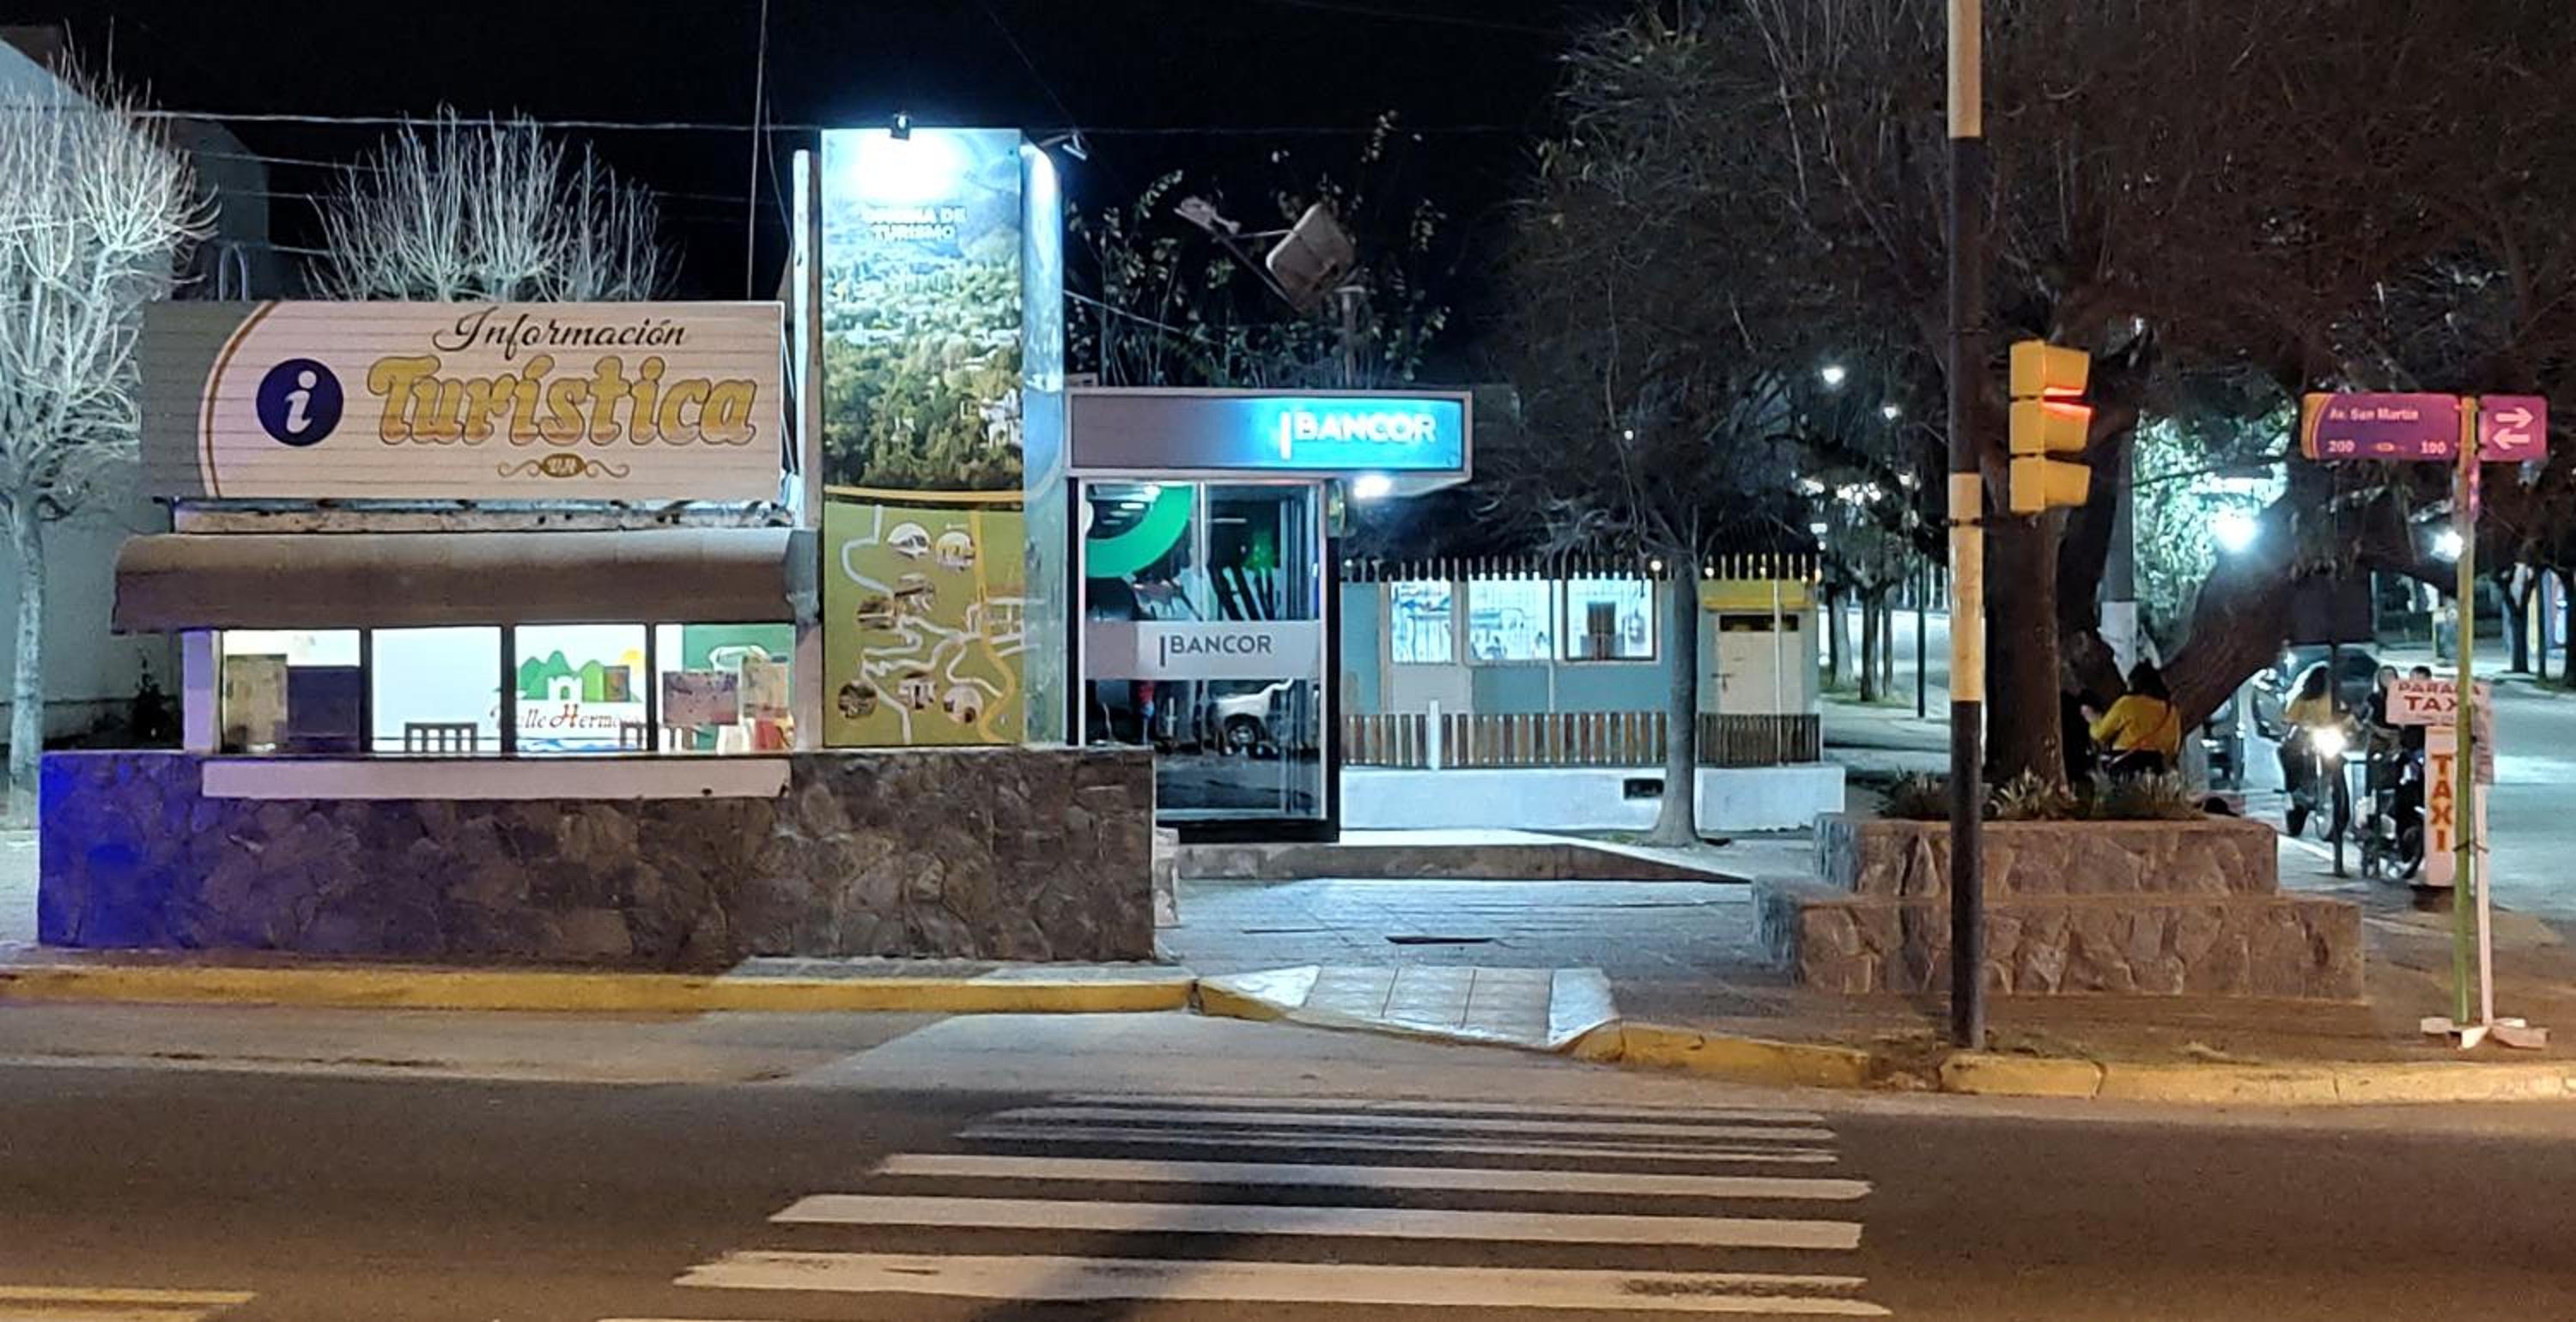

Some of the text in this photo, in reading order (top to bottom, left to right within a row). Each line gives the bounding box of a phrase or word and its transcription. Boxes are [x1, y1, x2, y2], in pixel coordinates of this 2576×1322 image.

[432, 306, 686, 361] Información
[366, 355, 757, 446] Turística
[2350, 407, 2376, 421] San
[1294, 410, 1437, 443] BANCOR
[2328, 440, 2356, 453] 200
[2420, 440, 2447, 455] 100
[1170, 634, 1273, 654] BANCOR
[2398, 682, 2481, 696] PARA
[2403, 695, 2461, 712] TAX
[2430, 754, 2453, 852] TAXI
